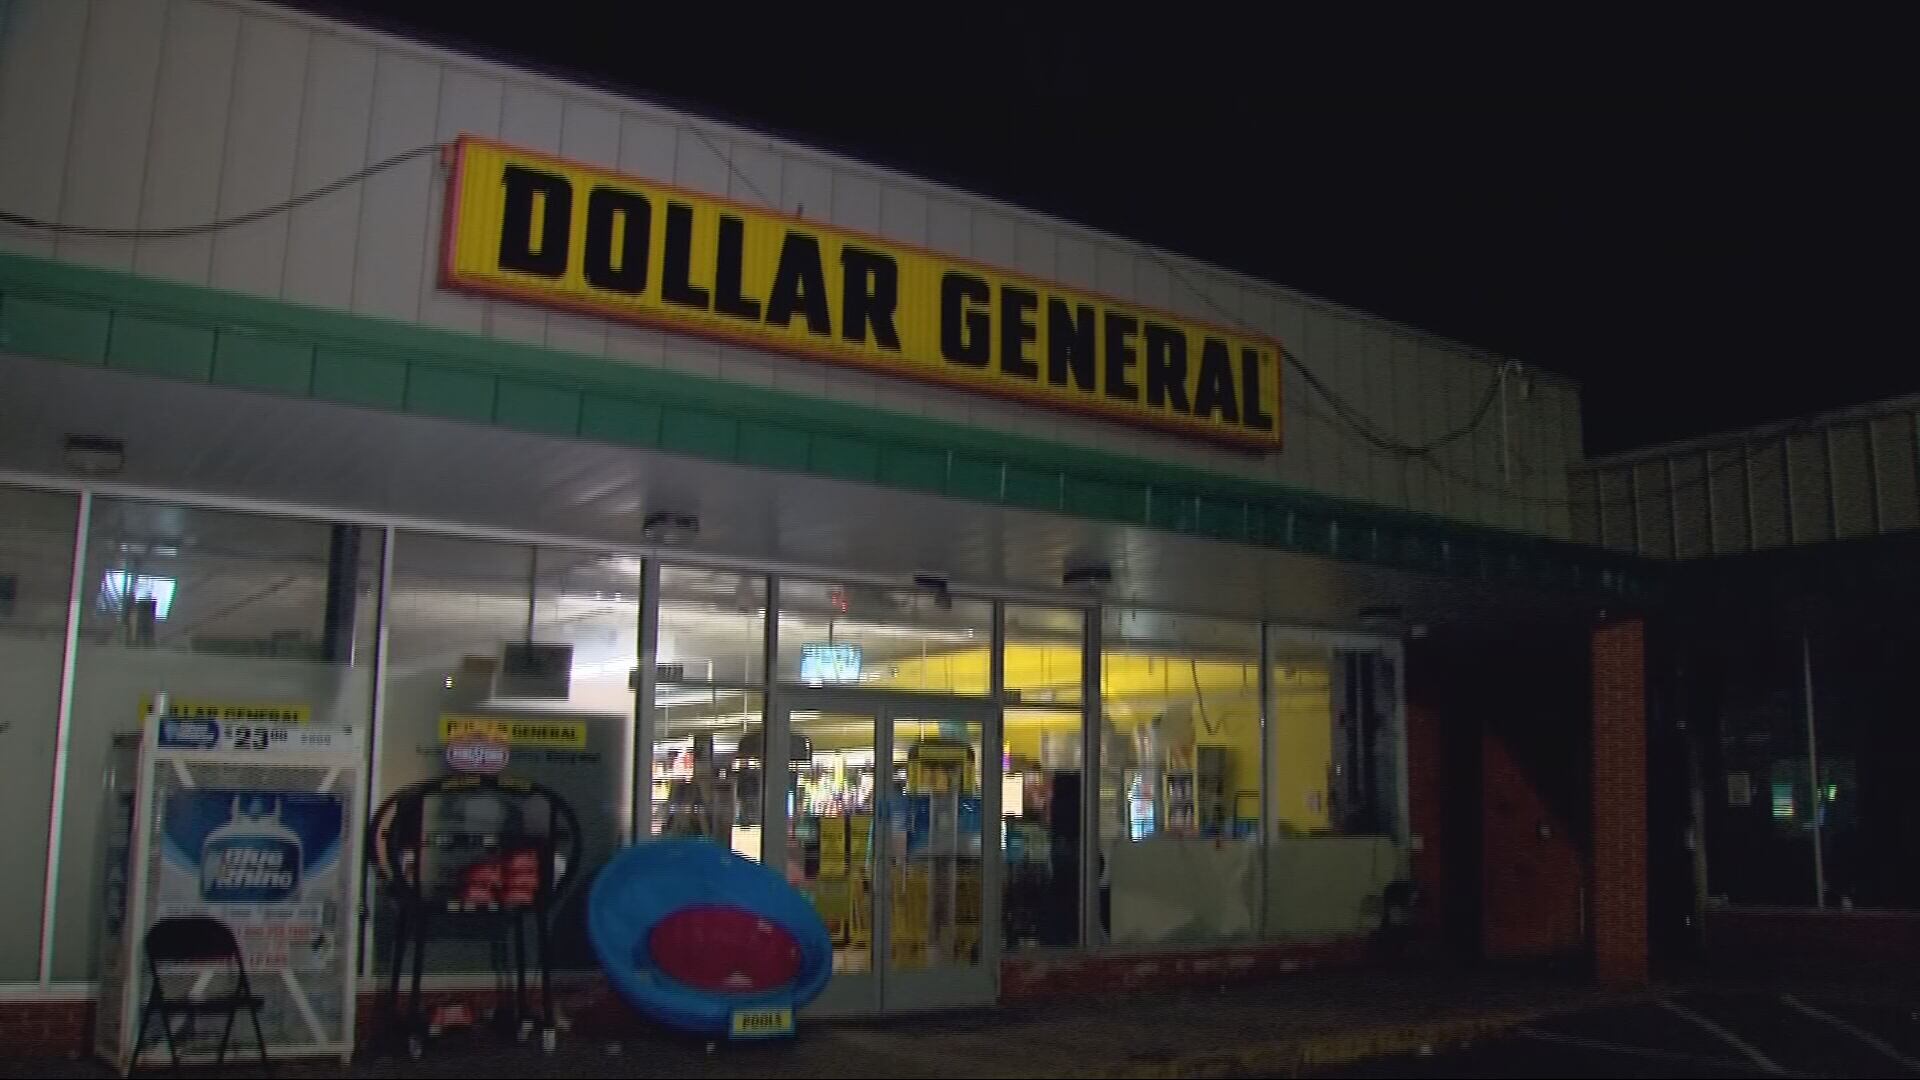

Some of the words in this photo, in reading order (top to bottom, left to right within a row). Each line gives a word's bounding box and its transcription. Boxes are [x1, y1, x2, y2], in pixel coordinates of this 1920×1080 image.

[500, 163, 901, 352] DOLLAR
[940, 270, 1273, 431] GENERAL
[511, 725, 577, 742] GENERAL
[741, 1012, 783, 1030] POOLS
